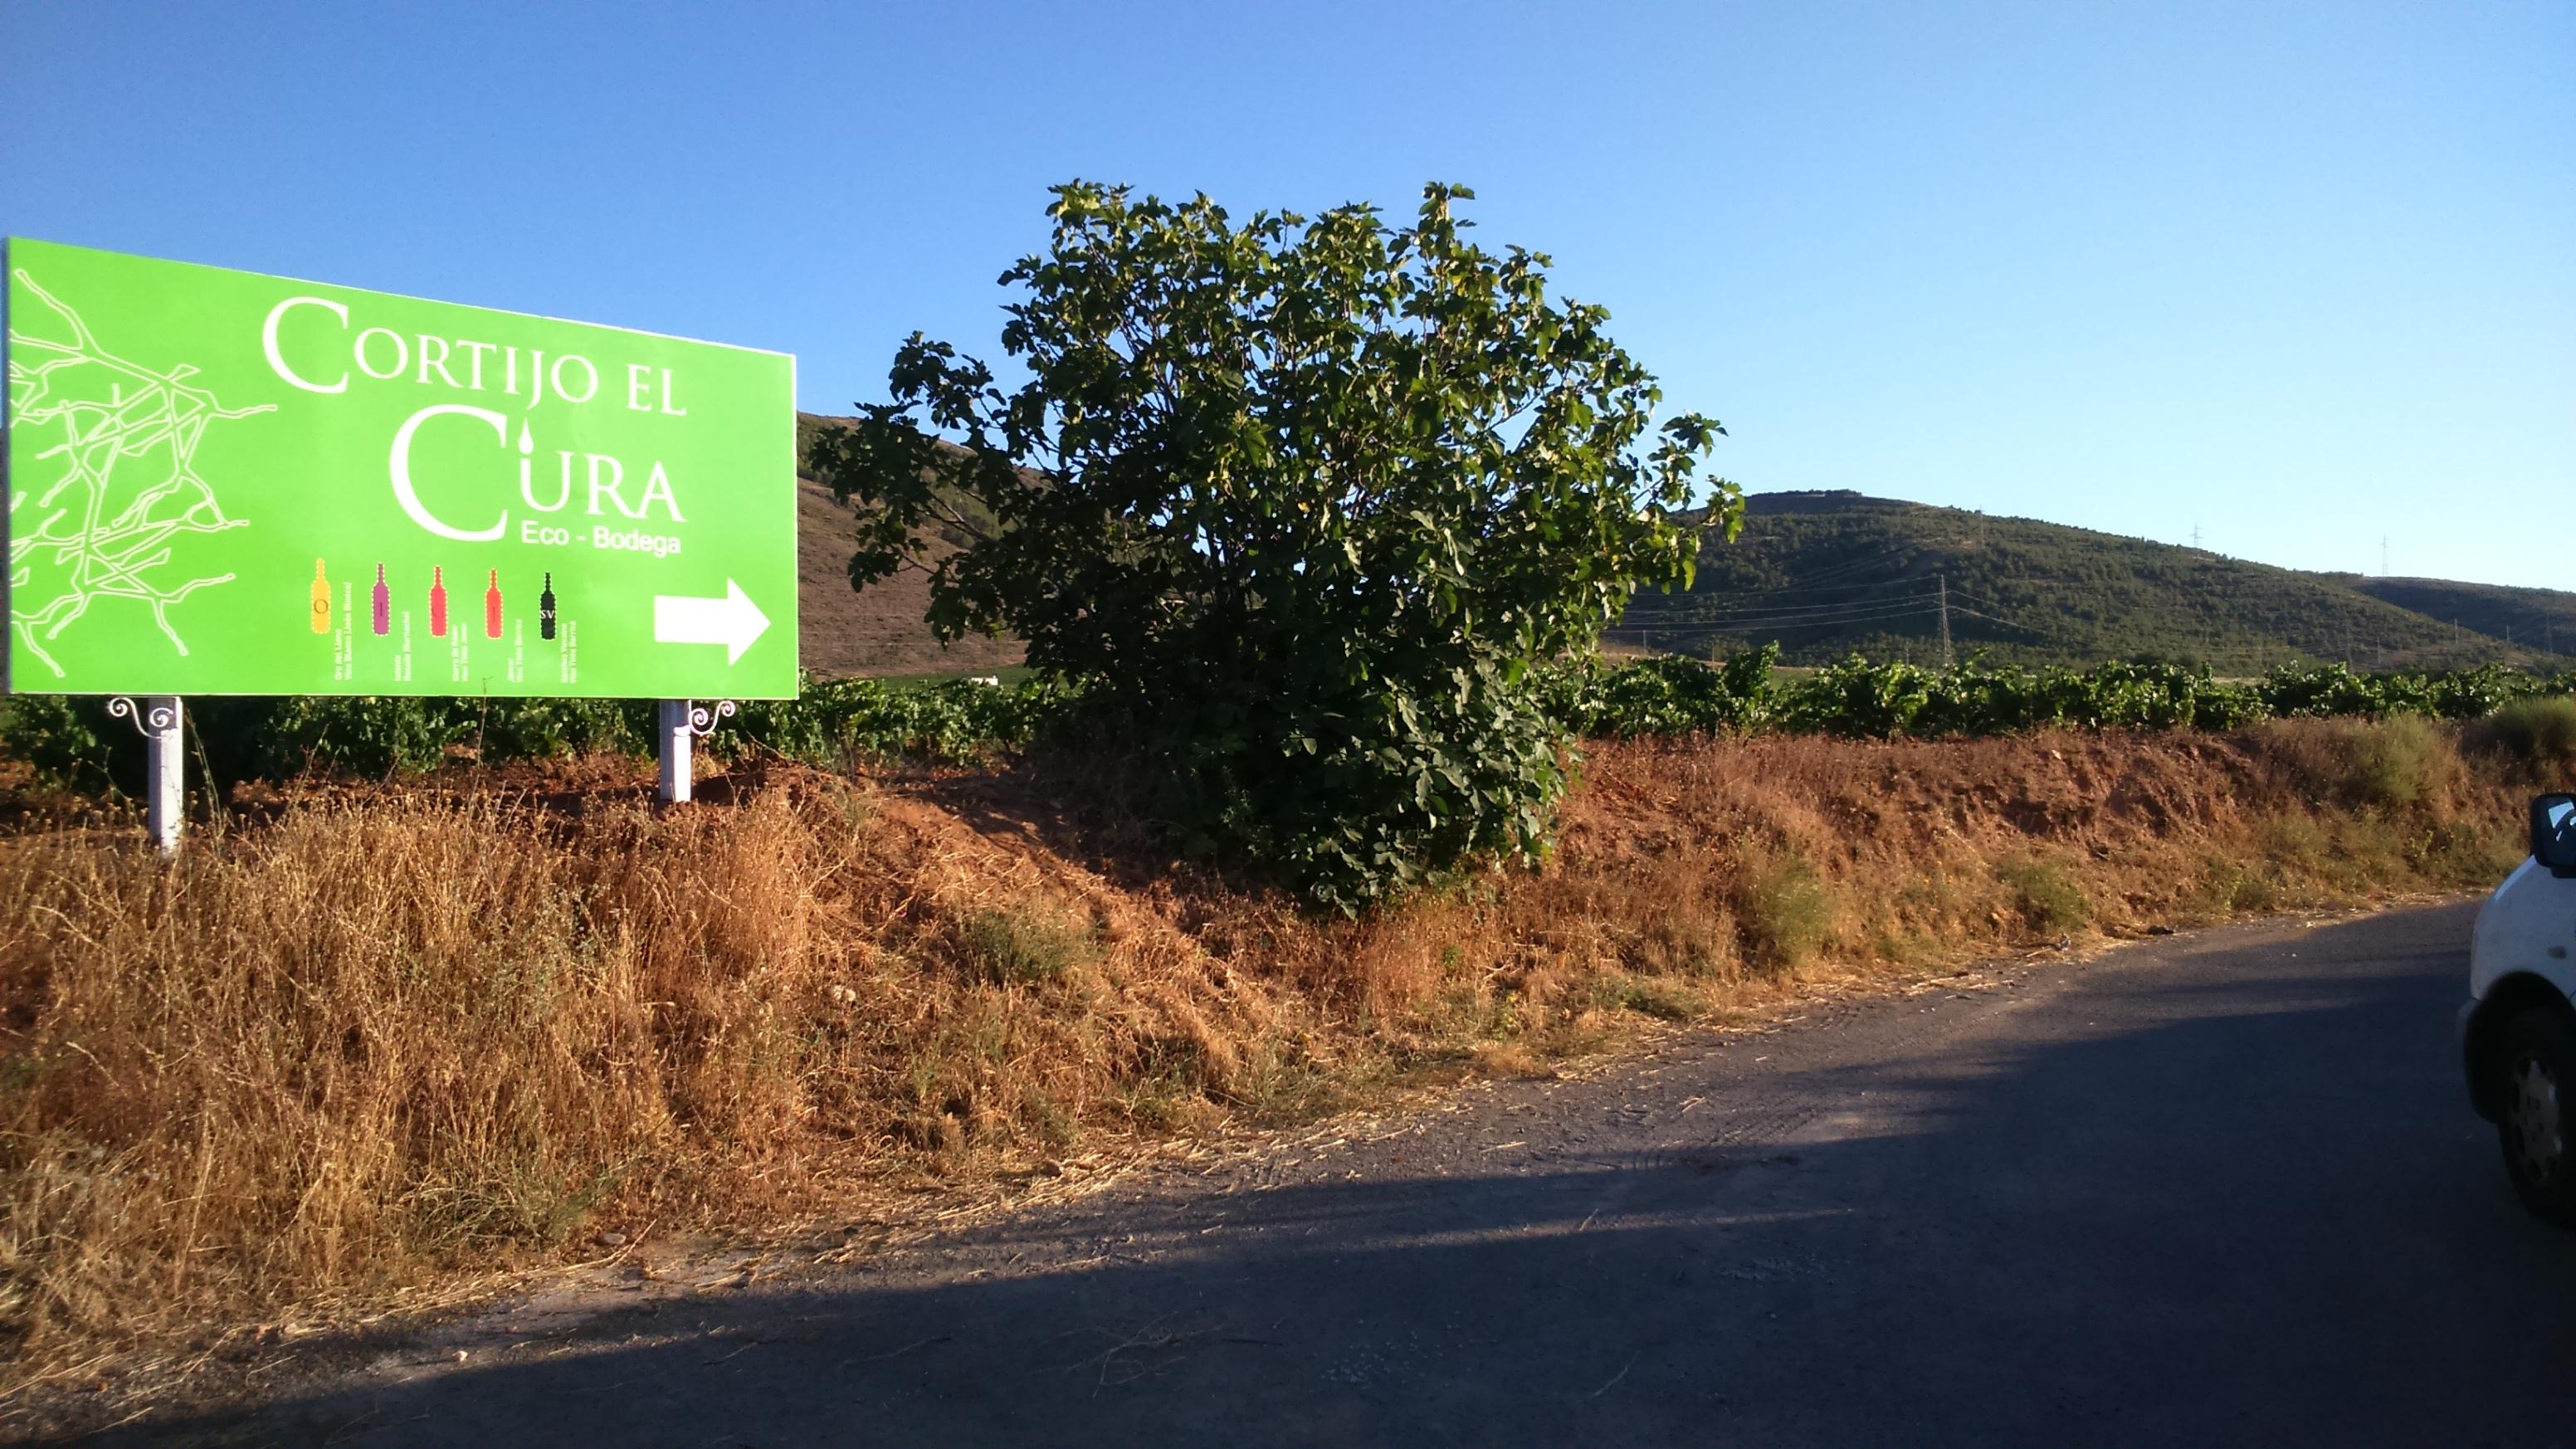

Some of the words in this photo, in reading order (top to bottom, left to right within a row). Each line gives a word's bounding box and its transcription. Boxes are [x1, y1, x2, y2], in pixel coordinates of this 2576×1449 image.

[263, 296, 599, 410] CORTIJO
[627, 365, 687, 416] EL
[389, 403, 688, 541] CURA
[521, 520, 569, 545] Eco
[593, 525, 681, 559] Bodega
[539, 609, 556, 620] SV
